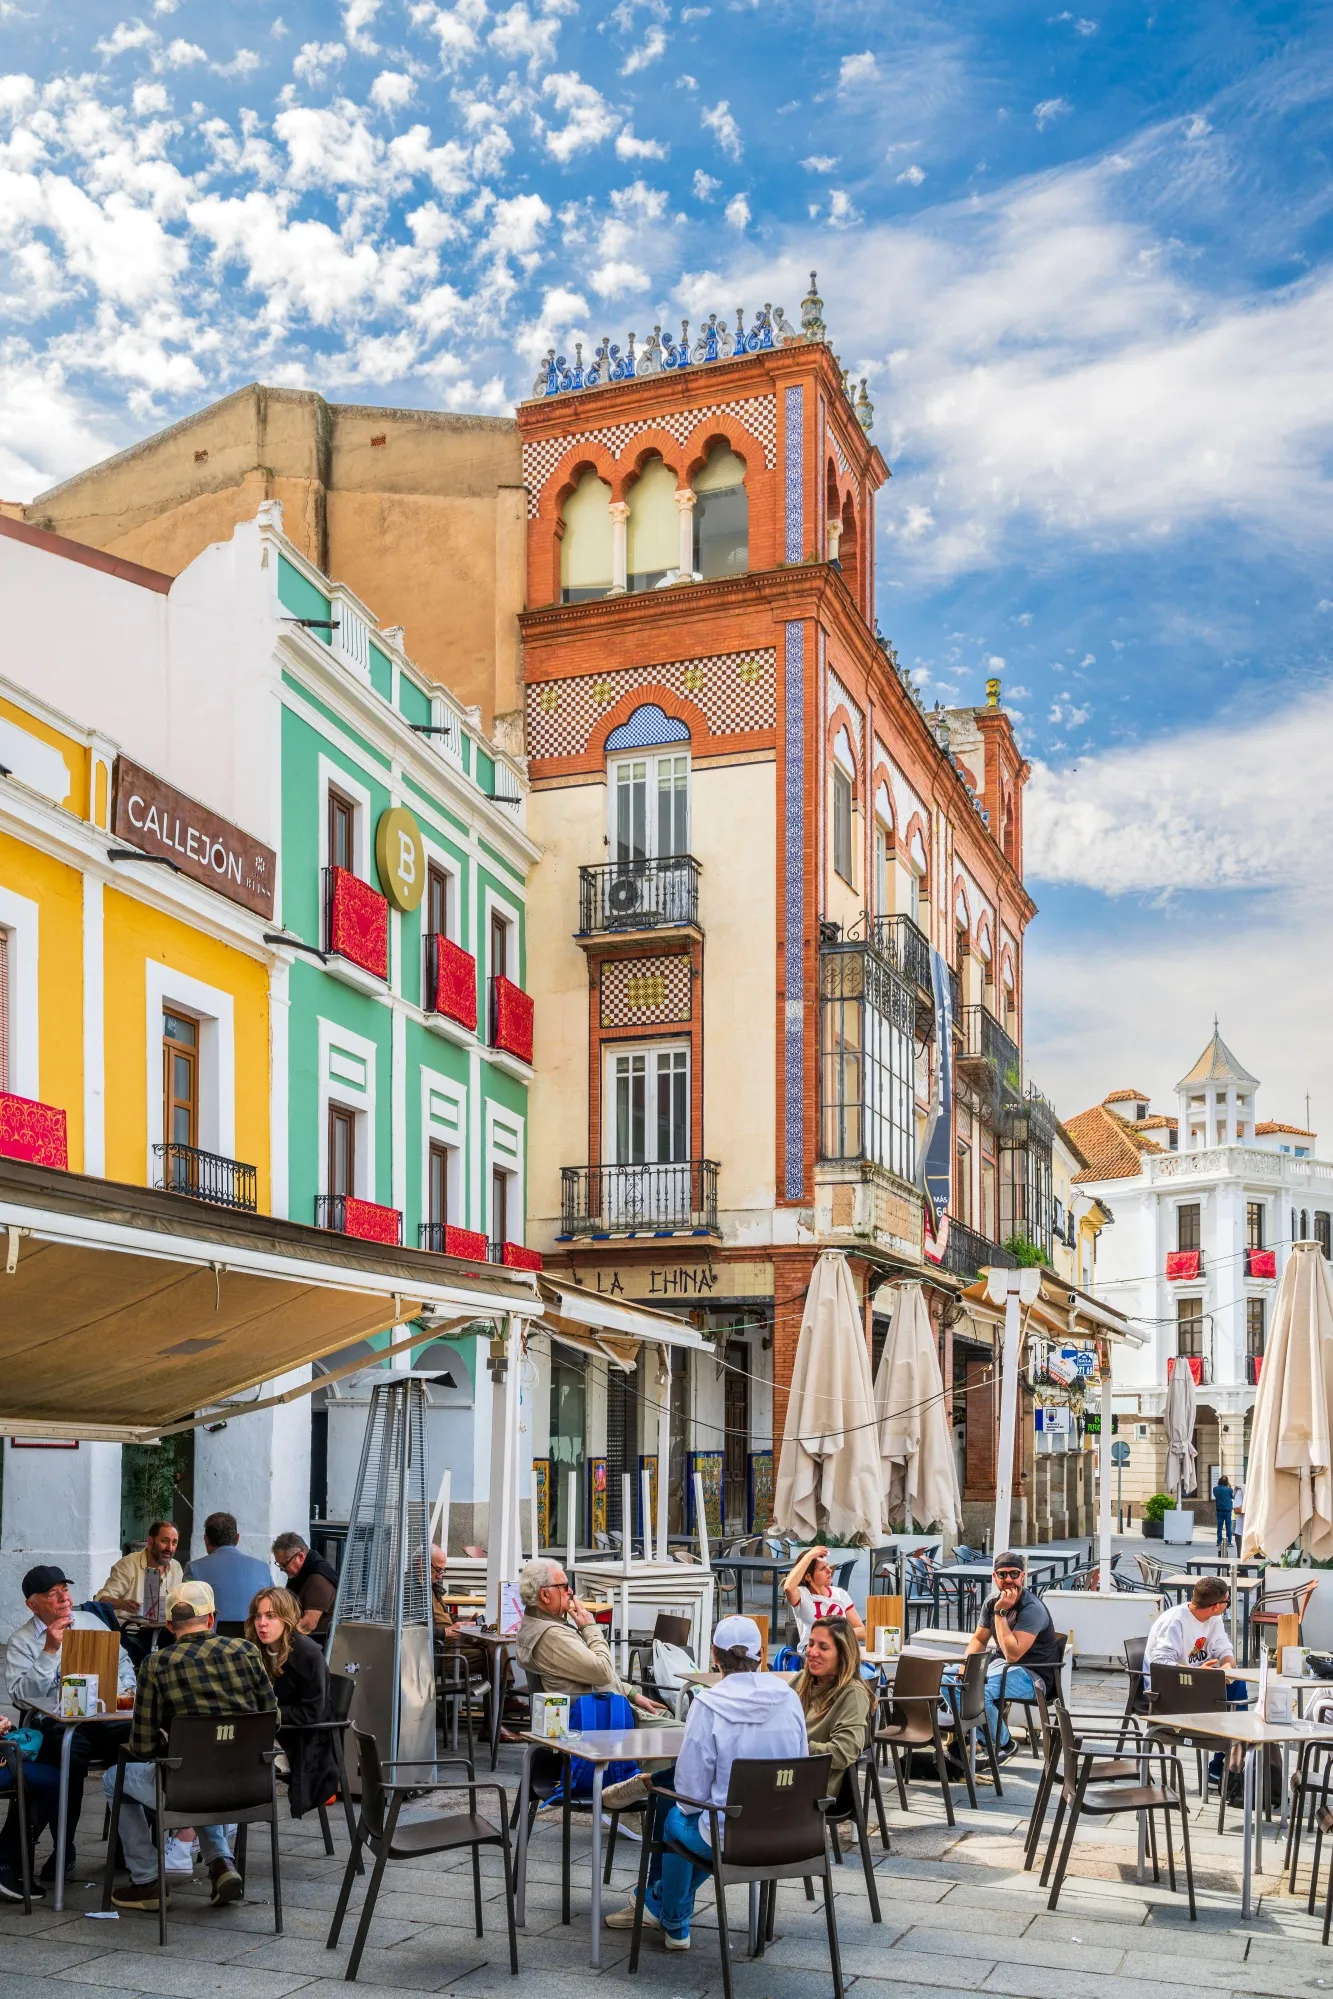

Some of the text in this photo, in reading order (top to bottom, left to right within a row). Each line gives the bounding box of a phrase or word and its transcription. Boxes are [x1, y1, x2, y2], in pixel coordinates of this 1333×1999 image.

[128, 795, 242, 885] CALLEJÓN
[397, 829, 416, 884] B
[933, 1194, 948, 1204] MÁS
[597, 1267, 713, 1295] LA CHINA
[216, 1724, 236, 1741] m
[776, 1769, 794, 1786] m
